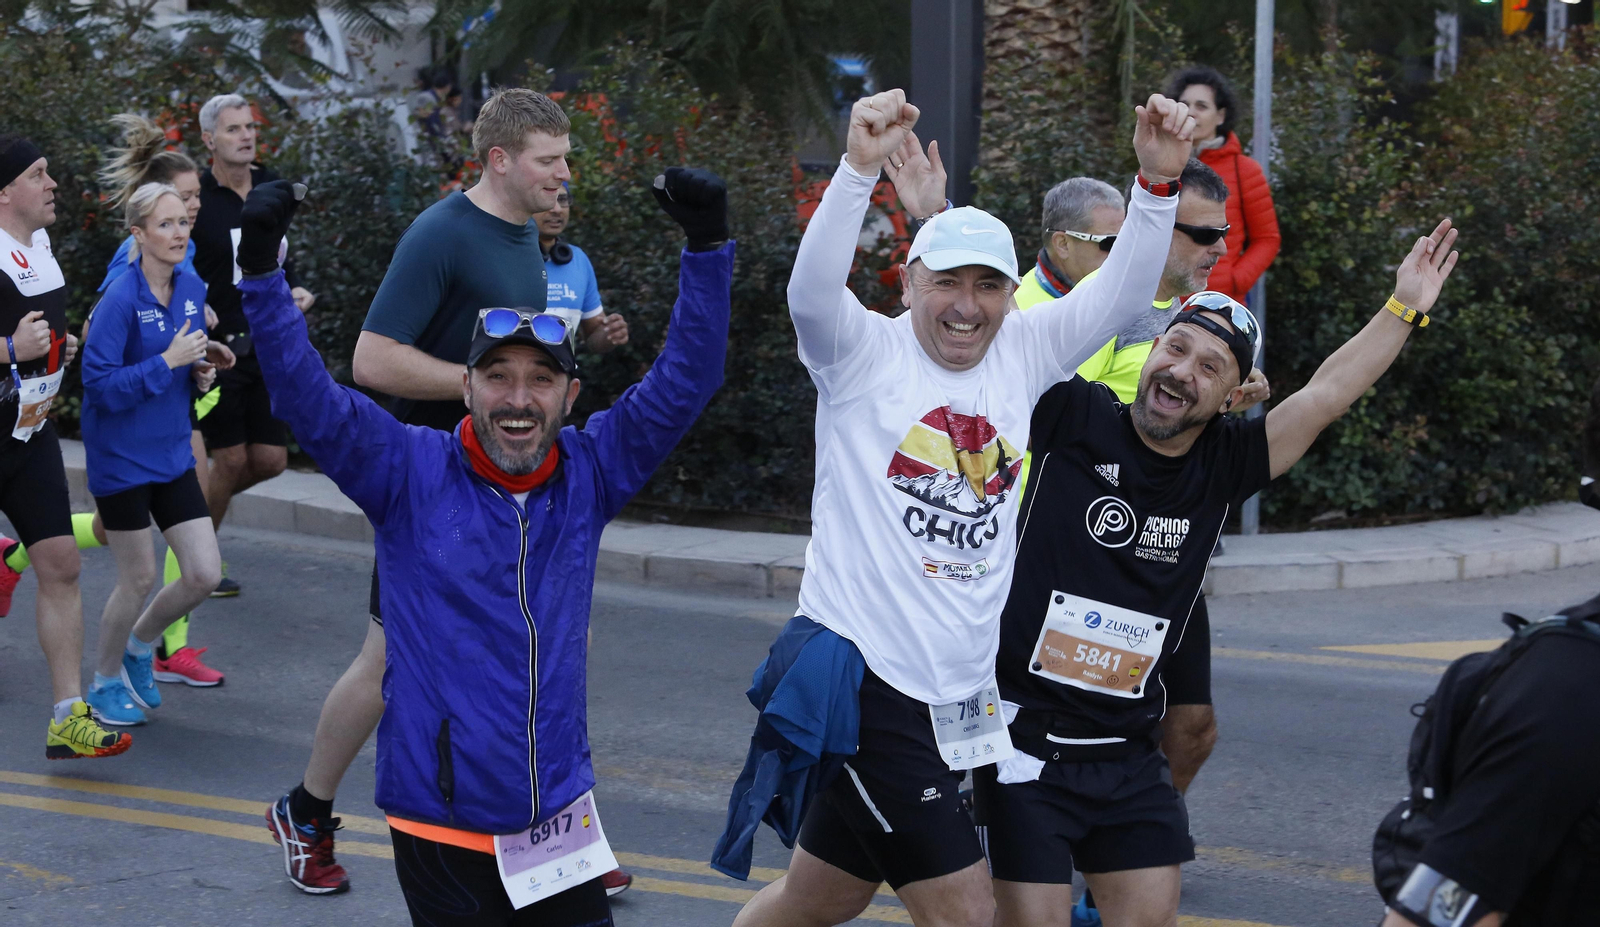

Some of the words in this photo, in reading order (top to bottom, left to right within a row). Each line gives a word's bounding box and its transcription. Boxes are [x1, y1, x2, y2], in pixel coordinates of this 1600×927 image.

[1094, 464, 1120, 487] adidas
[1063, 609, 1076, 618] 21K
[1104, 618, 1150, 638] ZURICH
[1073, 643, 1122, 672] 5841
[957, 698, 980, 721] 7198
[530, 812, 573, 845] 6917
[546, 843, 563, 854] Carlos
